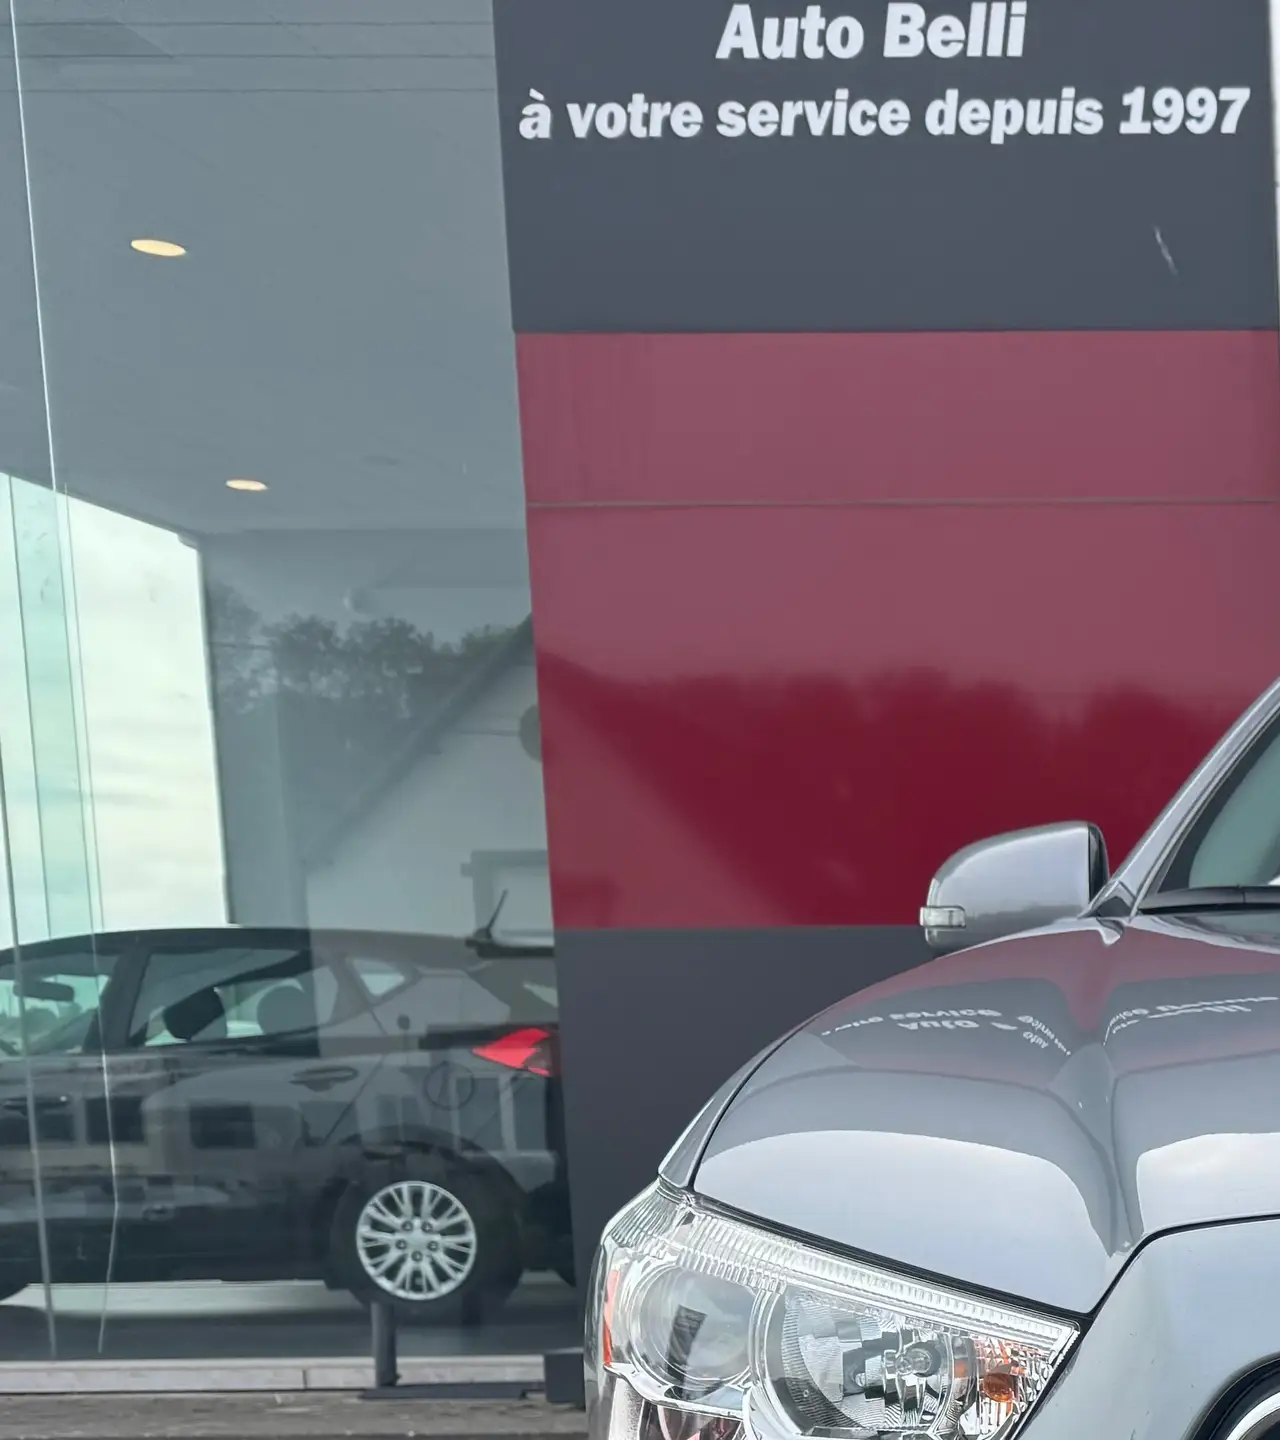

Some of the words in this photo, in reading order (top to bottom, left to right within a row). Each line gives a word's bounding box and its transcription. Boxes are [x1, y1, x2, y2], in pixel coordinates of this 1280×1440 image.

[715, 3, 865, 60] Auto
[883, 0, 1028, 59] Belli
[518, 88, 552, 139] à
[566, 93, 704, 139] votre
[716, 88, 911, 138] service
[925, 87, 1104, 145] depuis
[1119, 86, 1251, 135] 1997
